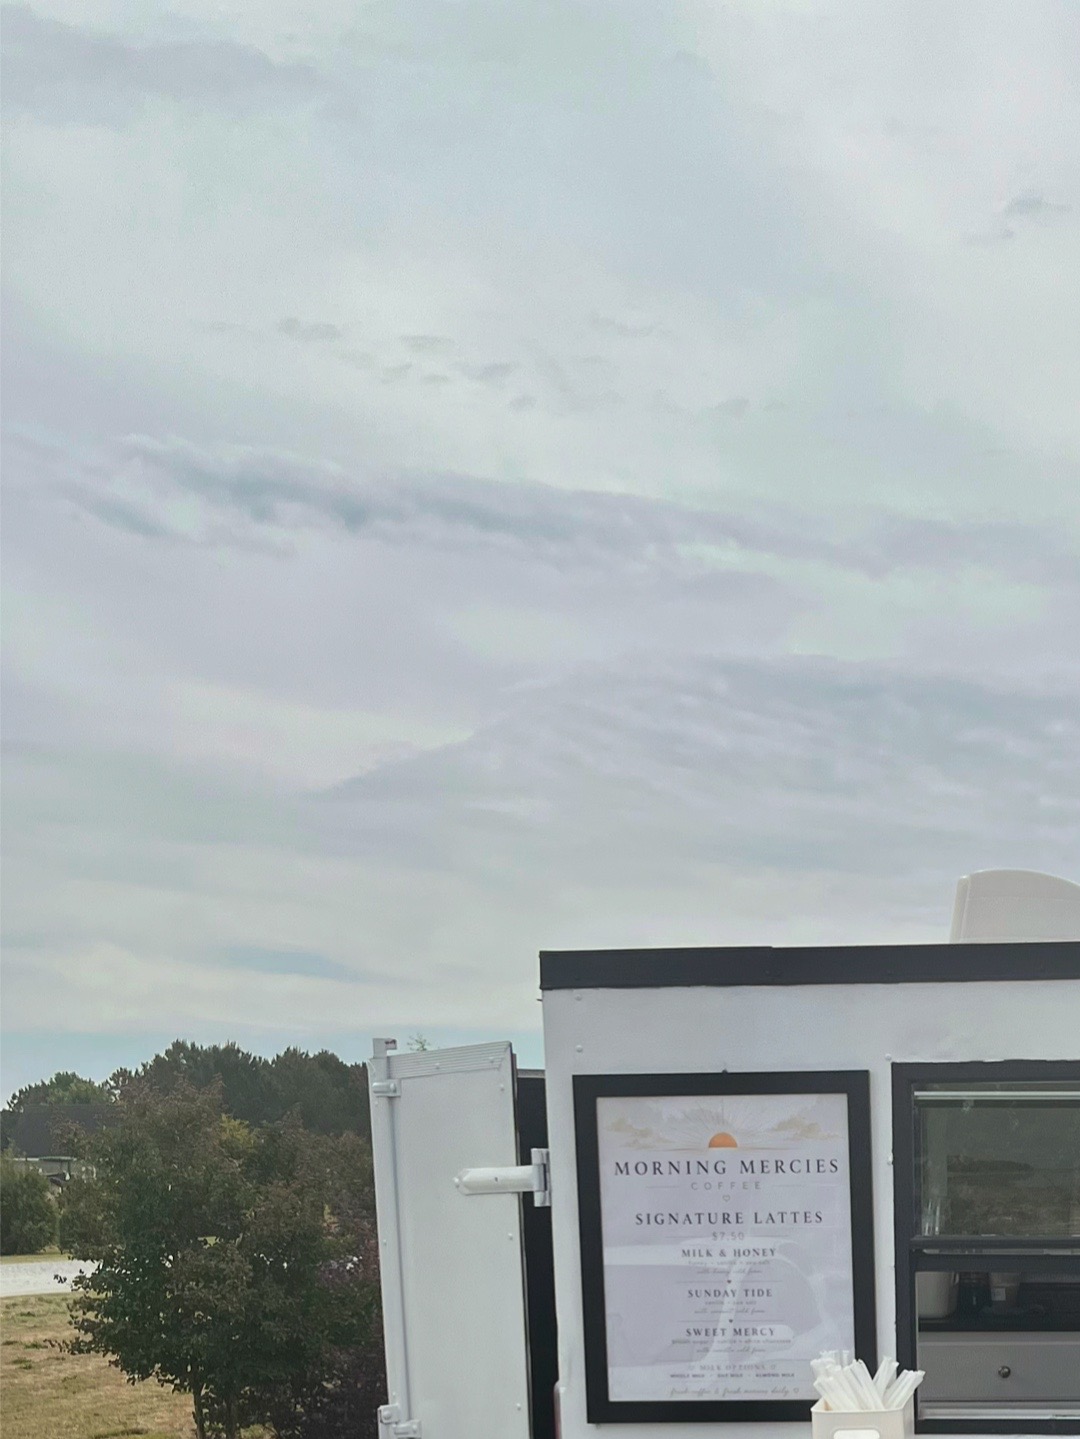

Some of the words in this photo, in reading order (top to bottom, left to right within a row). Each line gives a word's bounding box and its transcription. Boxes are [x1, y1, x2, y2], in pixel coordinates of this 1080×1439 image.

[614, 1160, 727, 1176] MORNING
[739, 1158, 839, 1175] MERCIES
[691, 1181, 762, 1191] COFFEE
[635, 1212, 745, 1226] SIGNATURE
[754, 1211, 824, 1225] LATTES
[712, 1231, 746, 1241] $7.50
[681, 1248, 713, 1258] MILK
[719, 1248, 727, 1257] &
[733, 1247, 776, 1257] HONEY
[687, 1289, 737, 1298] SUNDAY
[743, 1288, 773, 1298] TIDE
[685, 1327, 727, 1337] SWEET
[733, 1327, 776, 1336] MERCY
